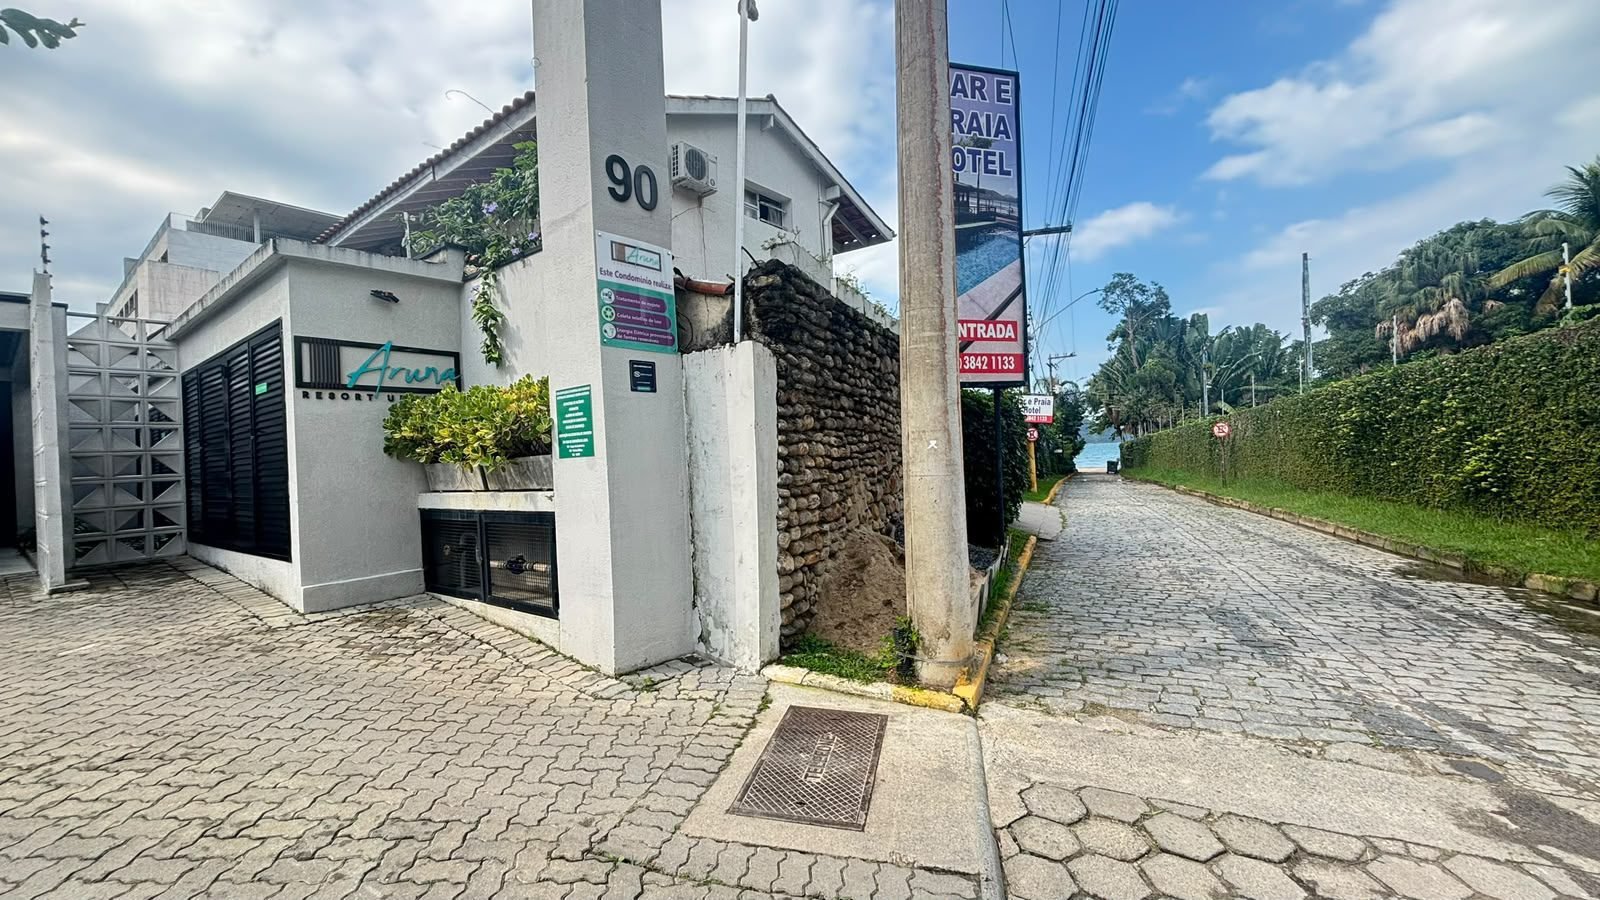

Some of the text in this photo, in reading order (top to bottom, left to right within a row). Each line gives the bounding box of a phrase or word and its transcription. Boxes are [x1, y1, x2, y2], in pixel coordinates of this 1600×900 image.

[950, 72, 1013, 106] AR E
[951, 107, 1013, 142] RAIA
[951, 145, 1014, 179] OTEL
[605, 154, 659, 211] 90
[625, 247, 660, 267] Aruna
[600, 267, 613, 278] Este
[958, 323, 1016, 339] NTRADA
[346, 340, 463, 399] Aruna
[963, 355, 988, 370] 3842
[991, 355, 1015, 370] 1133
[302, 390, 374, 402] RESORT
[1033, 397, 1051, 406] Praia
